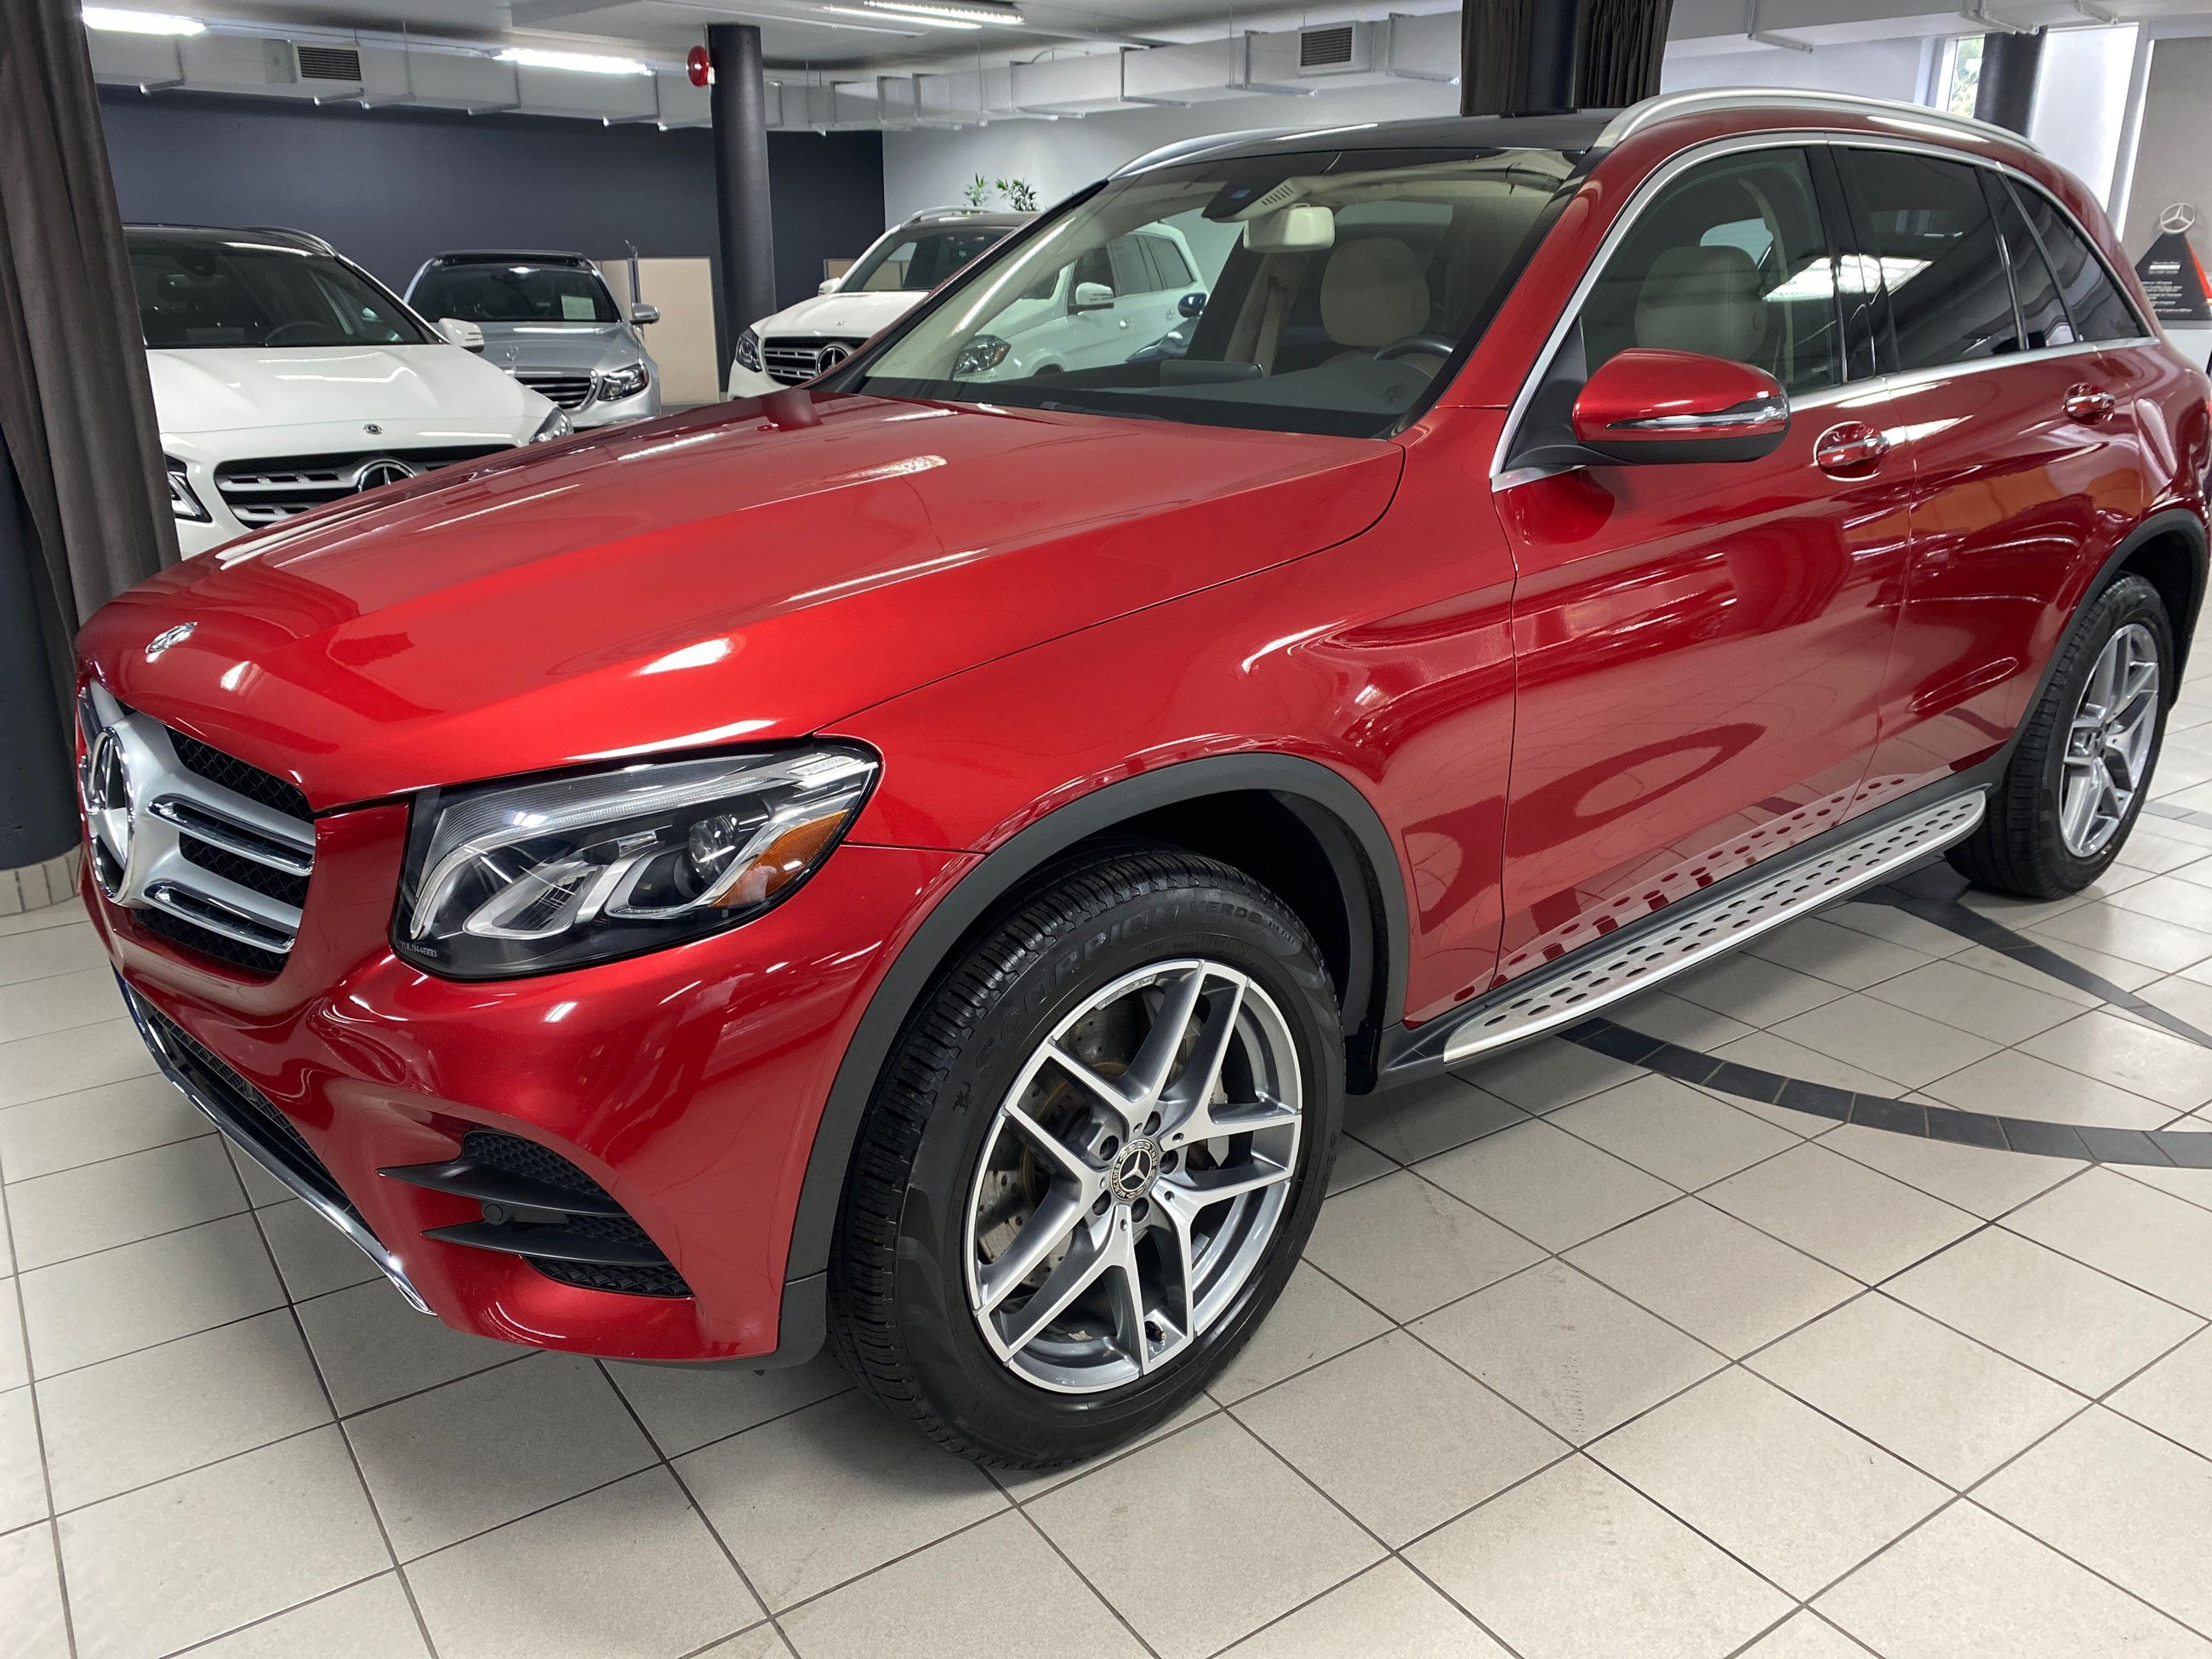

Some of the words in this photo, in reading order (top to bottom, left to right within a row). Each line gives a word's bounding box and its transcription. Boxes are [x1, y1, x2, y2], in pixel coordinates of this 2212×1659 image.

[975, 904, 1179, 1079] SCORPION
[1190, 900, 1263, 924] VERDE
[1149, 1147, 1158, 1167] BENZ
[1113, 1162, 1126, 1198] MERCEDES
